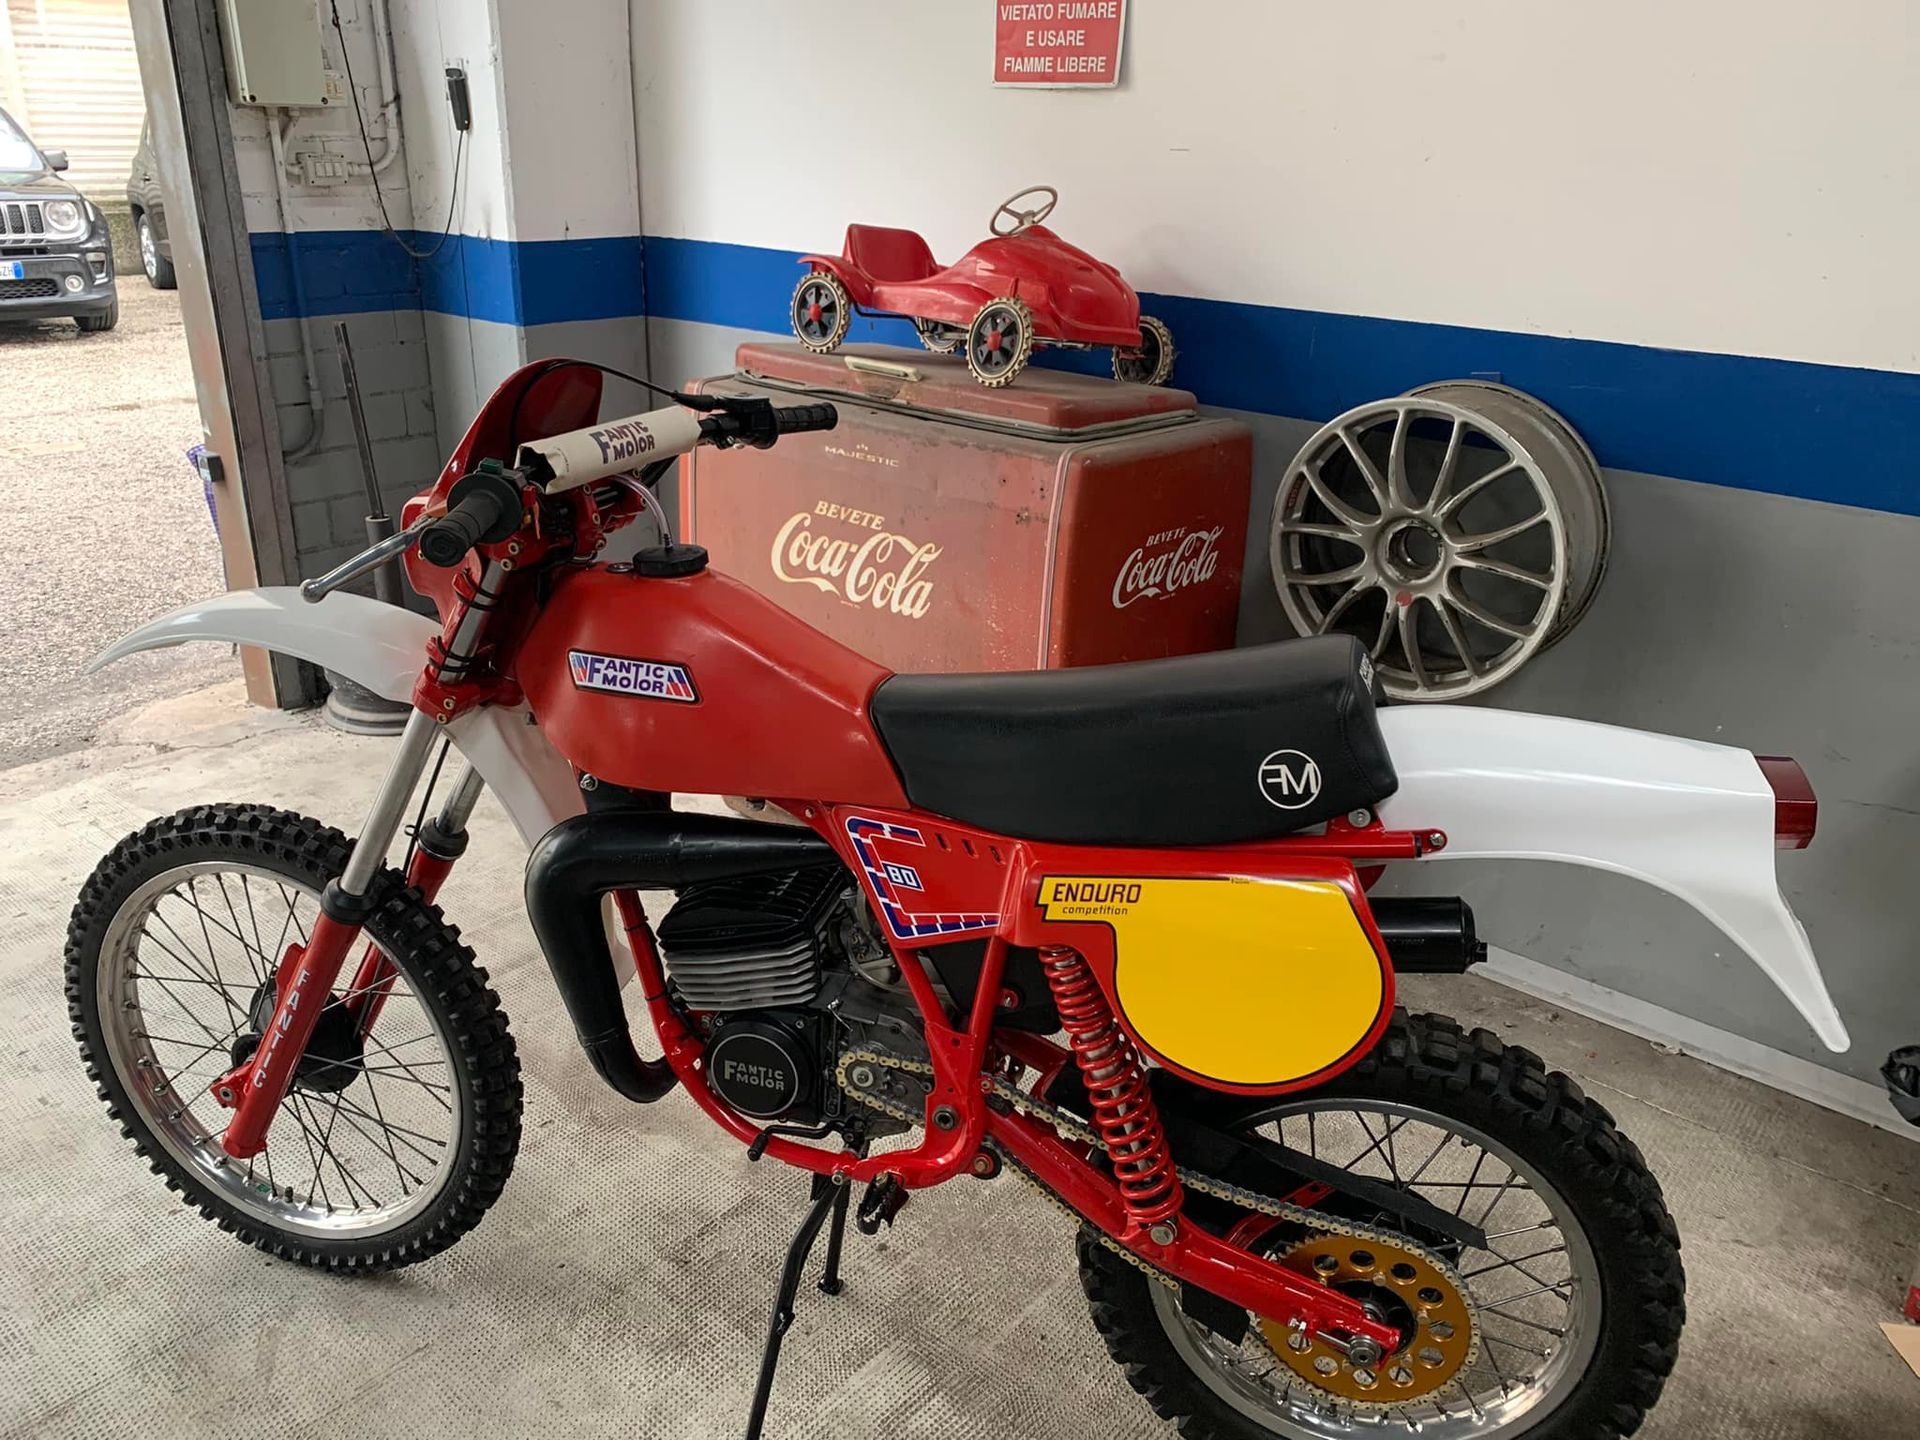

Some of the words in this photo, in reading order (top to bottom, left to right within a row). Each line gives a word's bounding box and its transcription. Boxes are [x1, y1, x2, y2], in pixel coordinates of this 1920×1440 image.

[1000, 4, 1054, 21] VIETATO
[1057, 2, 1118, 19] FUMARE
[1026, 30, 1035, 47] E
[1038, 29, 1085, 46] USARE
[1003, 56, 1054, 73] FIAMME
[1056, 56, 1107, 73] LIBERE
[590, 421, 649, 464] FANTIC
[613, 434, 655, 461] MOTOR
[824, 445, 899, 468] MAJESTIC
[814, 500, 886, 530] BEVETE
[1145, 526, 1187, 547] BEVETE
[771, 512, 944, 619] Coca-Cola
[1112, 525, 1224, 609] Coca-Cola
[587, 656, 665, 683] FANTIC
[602, 672, 665, 693] MOTOR
[886, 865, 918, 887] 80
[1052, 883, 1142, 903] ENDURO
[1062, 905, 1128, 915] competition
[253, 968, 310, 1088] FANTIC
[724, 1060, 784, 1080] FANTIC
[736, 1072, 785, 1091] MOTOR
